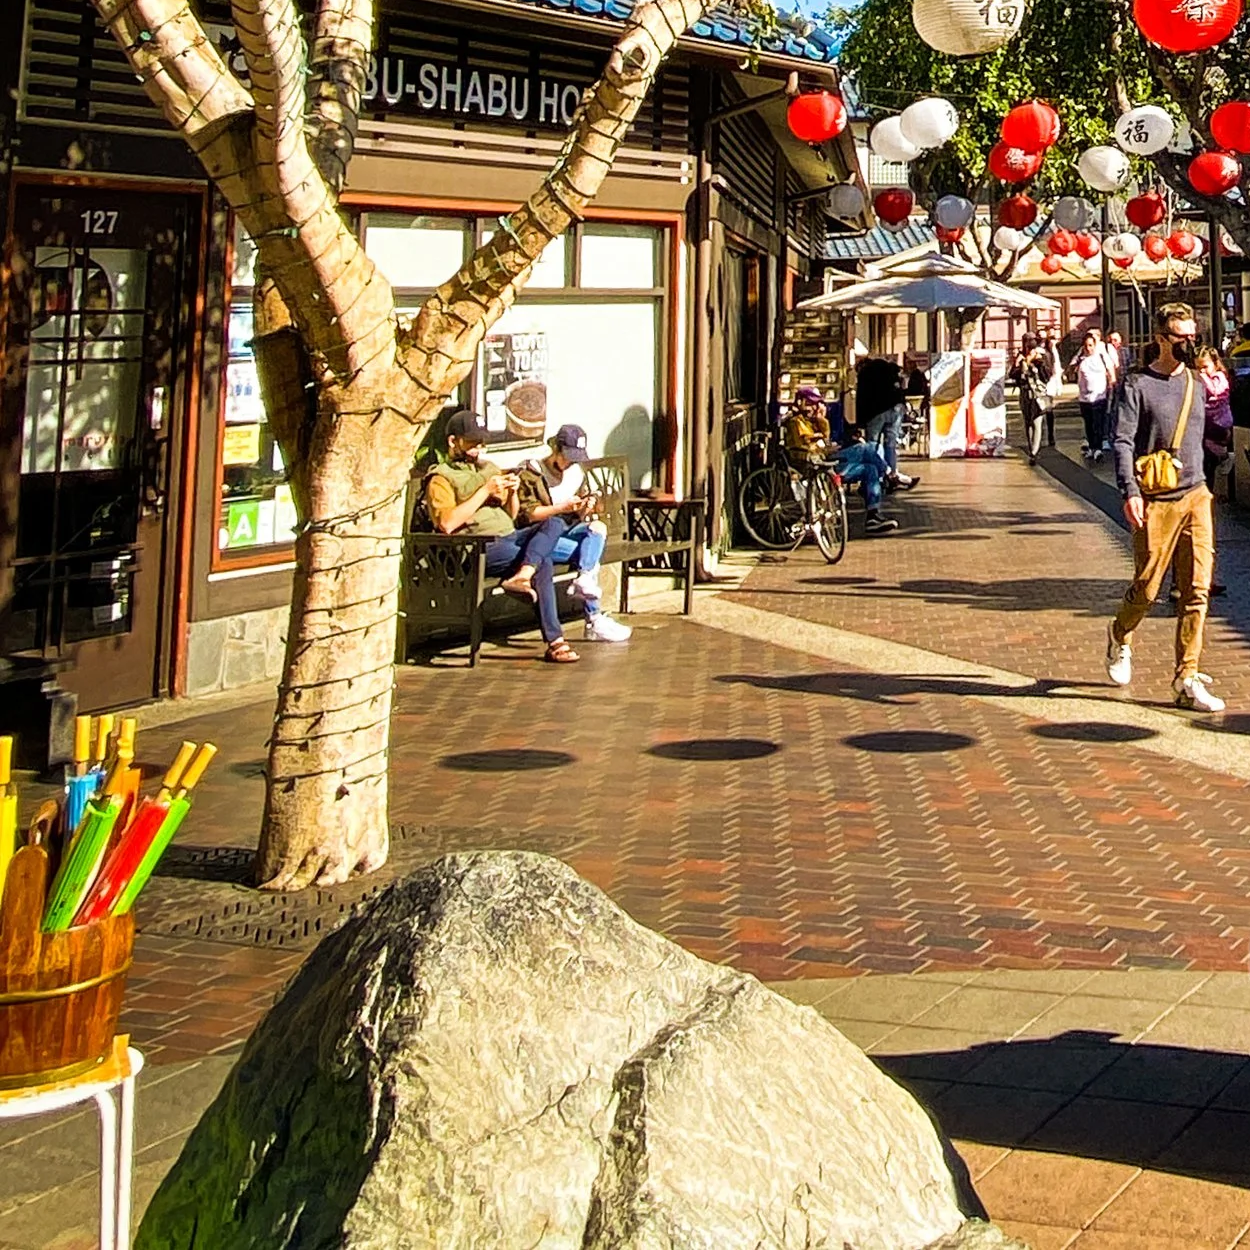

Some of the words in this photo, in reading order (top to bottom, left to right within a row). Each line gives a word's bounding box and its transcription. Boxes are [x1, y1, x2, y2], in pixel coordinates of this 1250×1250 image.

[1122, 119, 1150, 146] 福
[80, 210, 118, 235] 127
[232, 513, 254, 541] A
